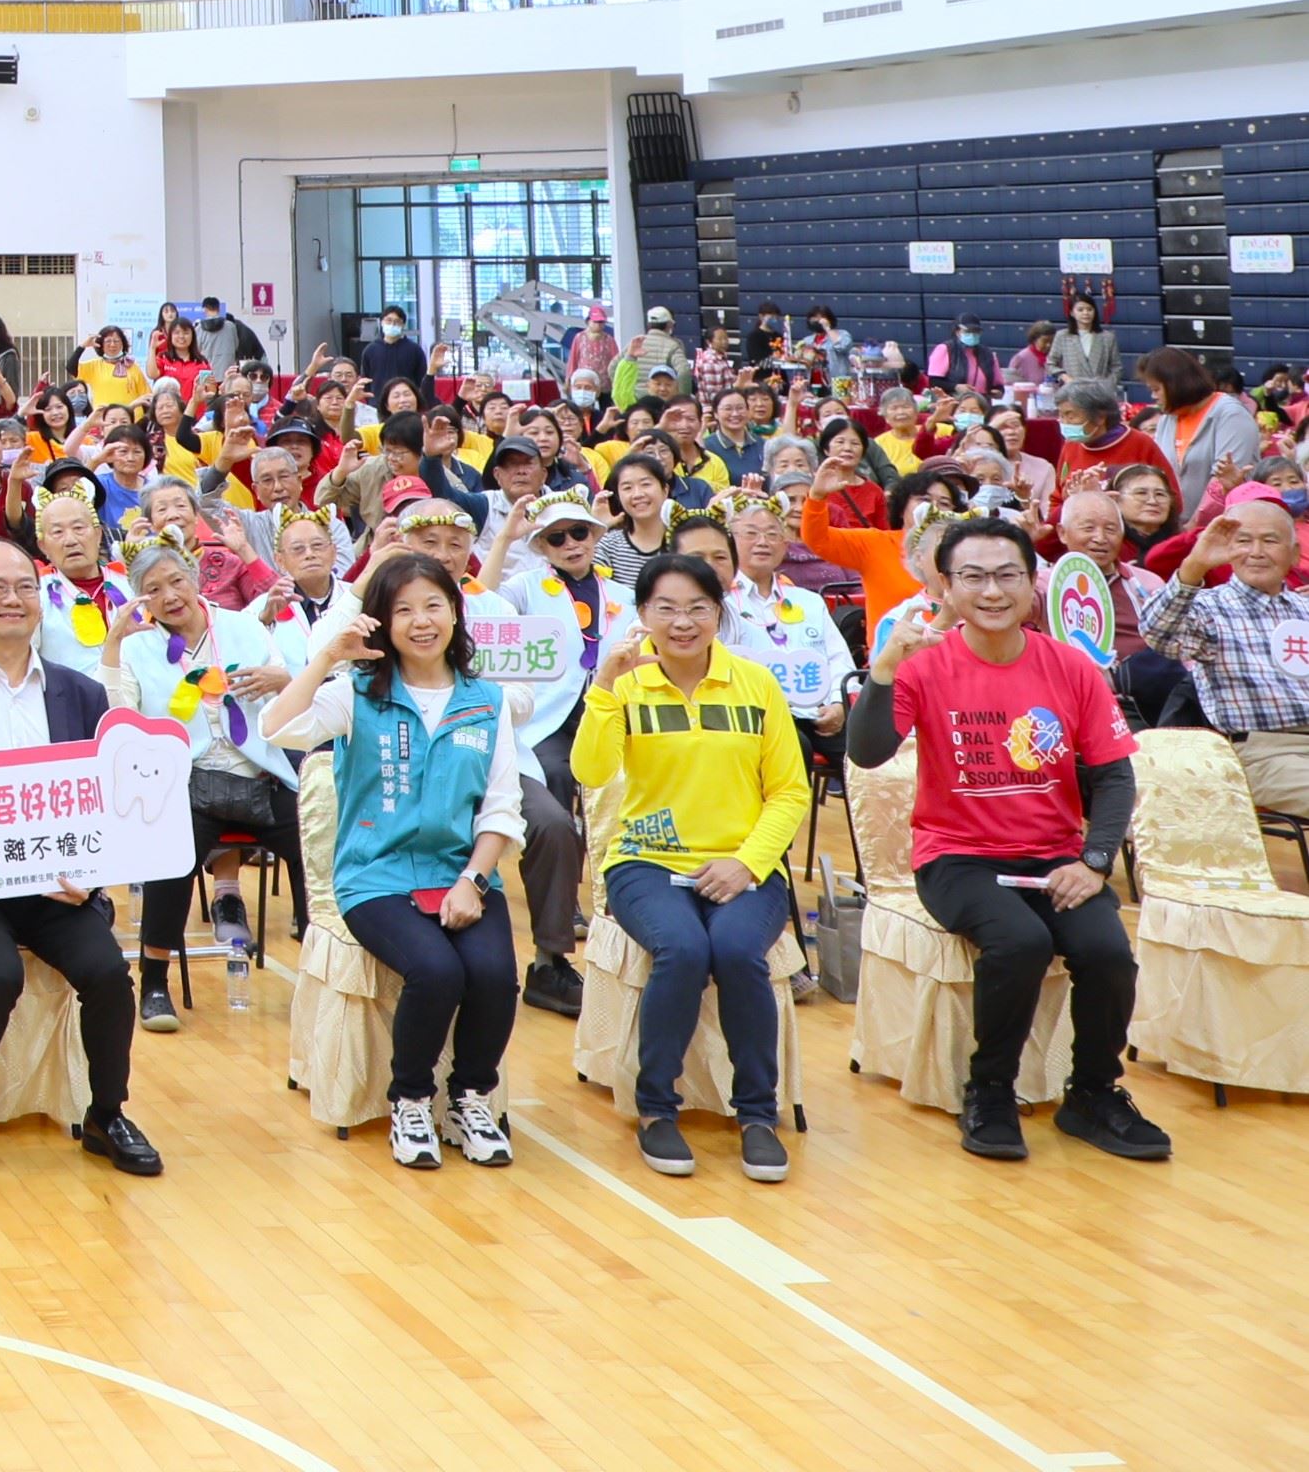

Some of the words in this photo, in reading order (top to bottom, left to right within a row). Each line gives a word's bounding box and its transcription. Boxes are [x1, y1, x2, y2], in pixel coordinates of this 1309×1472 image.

[1075, 609, 1097, 634] 1966
[471, 622, 522, 645] 健康
[949, 710, 1007, 726] TAIWAN
[952, 730, 993, 746] ORAL
[954, 751, 996, 766] CARE
[958, 770, 1050, 786] ASSOCIATION
